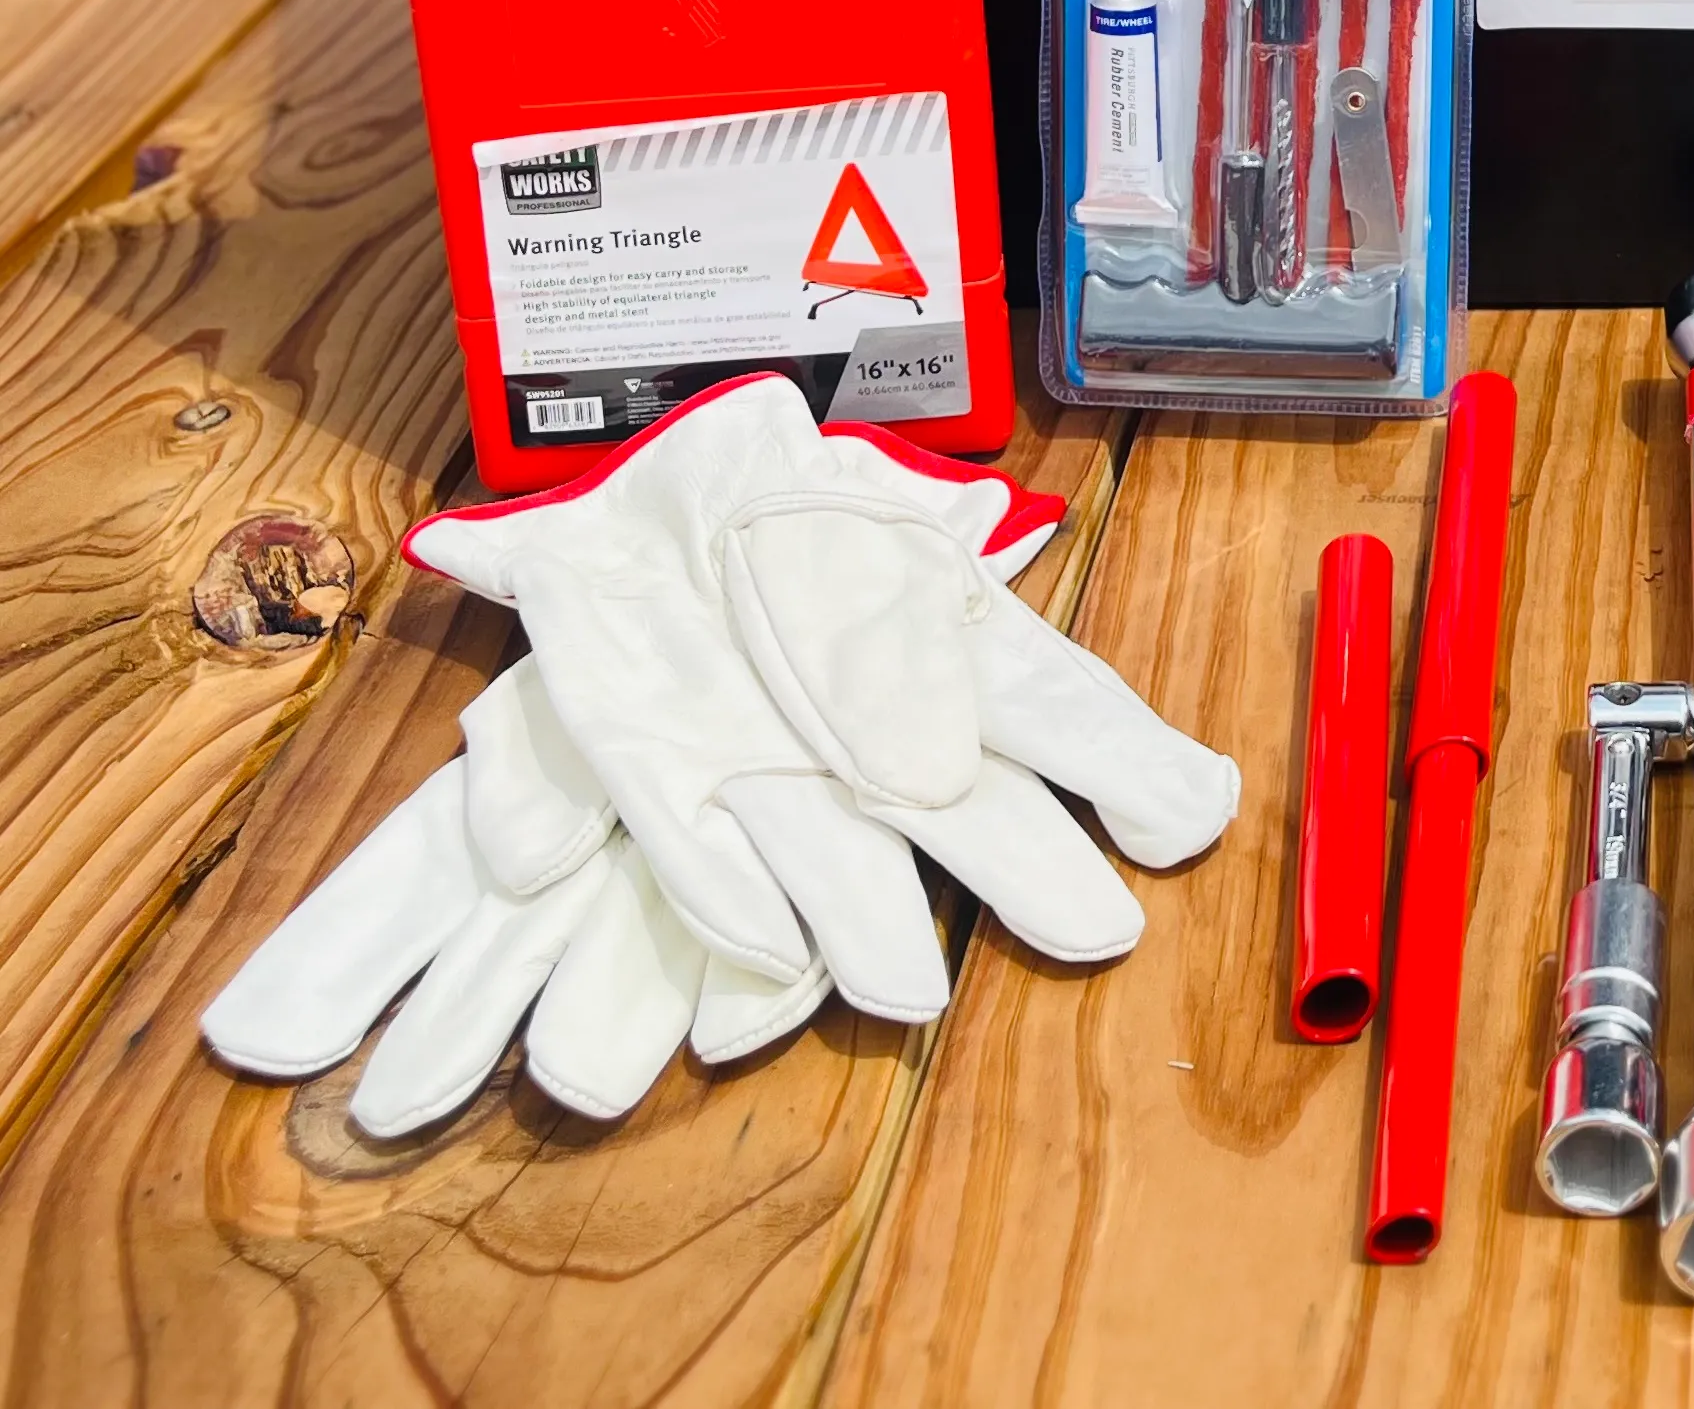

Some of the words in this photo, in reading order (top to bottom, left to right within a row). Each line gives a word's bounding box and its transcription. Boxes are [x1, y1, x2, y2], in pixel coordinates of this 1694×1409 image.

[1095, 15, 1153, 28] TIRE/WHEEL
[1111, 48, 1124, 97] Rubber
[1111, 101, 1125, 153] Cement
[509, 169, 593, 197] WORKS
[516, 198, 591, 211] PROFESSIONAL
[508, 233, 604, 256] Warning
[609, 225, 702, 249] Triangle
[520, 278, 566, 290] Foldable
[569, 275, 607, 286] design
[609, 273, 625, 282] for
[627, 271, 652, 281] easy
[655, 269, 683, 279] carry
[685, 267, 705, 276] and
[708, 264, 749, 275] storage
[523, 301, 549, 312] High
[552, 298, 597, 309] stability
[600, 296, 611, 305] of
[613, 291, 671, 305] equilateral
[674, 288, 717, 300] triangle
[525, 313, 562, 325] design
[565, 311, 585, 321] and
[588, 309, 618, 319] metal
[857, 359, 895, 381] 16"
[897, 362, 912, 378] x
[916, 354, 954, 375] 16"
[857, 385, 902, 396] 40.64cm
[912, 380, 956, 391] 40.64cm
